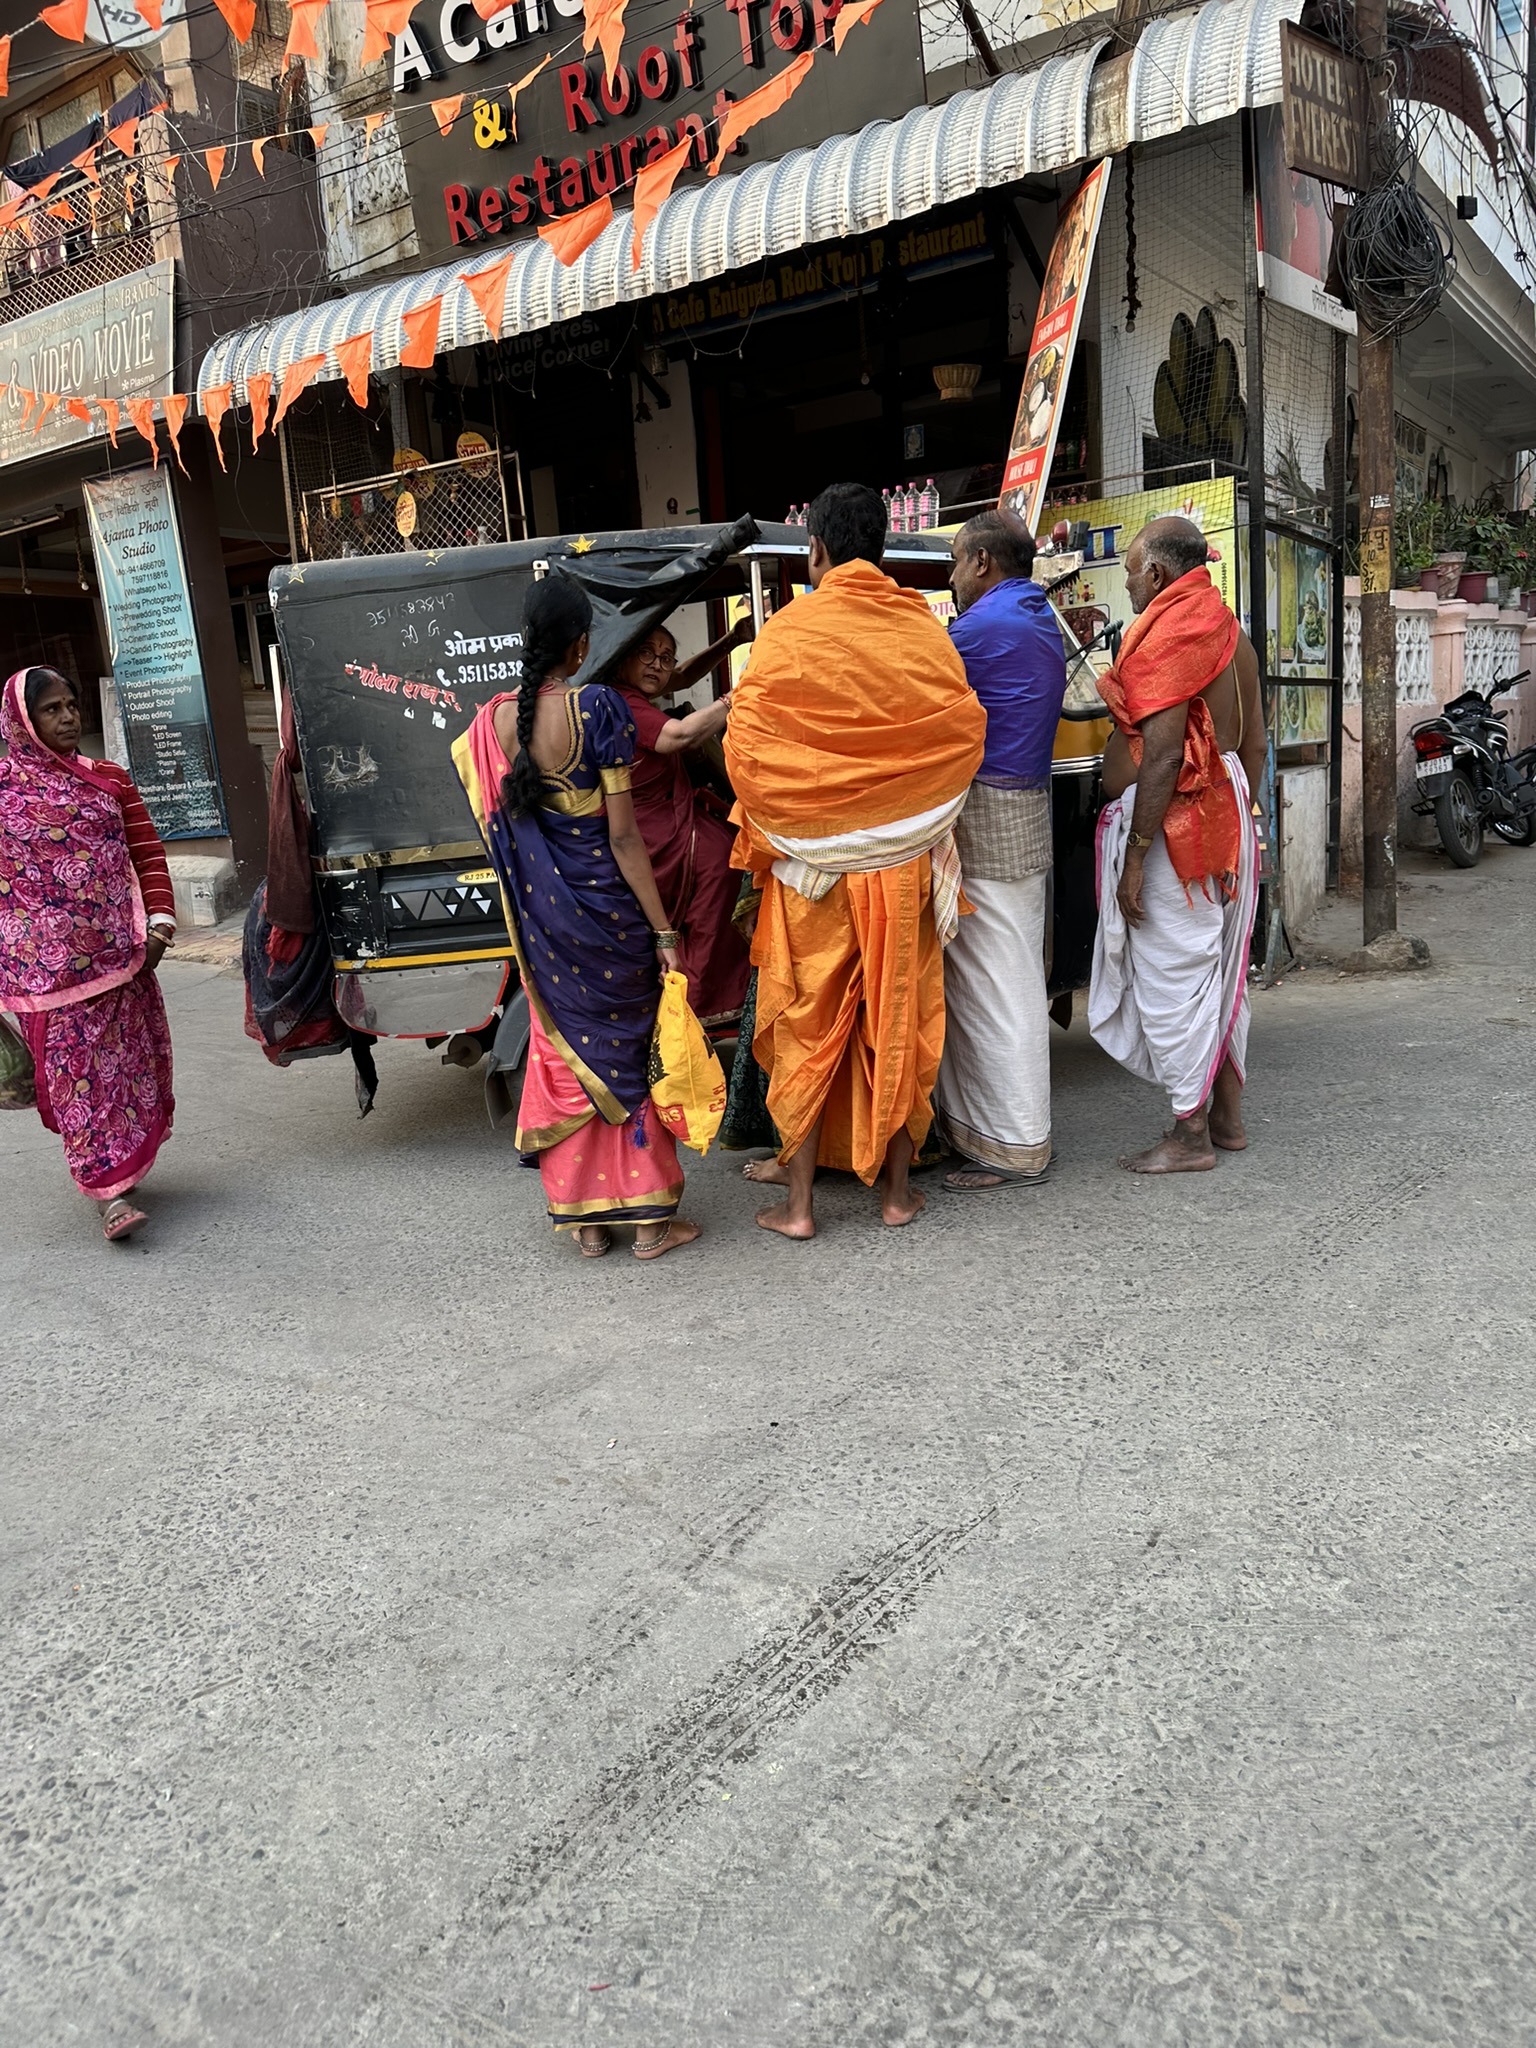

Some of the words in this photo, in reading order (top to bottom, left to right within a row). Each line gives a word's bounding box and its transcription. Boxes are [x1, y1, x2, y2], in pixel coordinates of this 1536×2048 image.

[393, 20, 432, 92] A
[472, 98, 508, 149] &
[559, 9, 694, 133] Roof
[1289, 40, 1346, 106] HOTEL
[1290, 95, 1361, 177] EVEREST
[443, 88, 738, 246] Restaurant
[668, 297, 707, 329] Cafe
[708, 275, 778, 321] Enigma
[779, 261, 824, 298] Roof
[827, 249, 867, 287] Top
[868, 210, 987, 274] Rstaurant
[30, 338, 85, 405] VIDEO
[93, 306, 155, 384] MOVIE
[129, 373, 155, 388] Plasma
[100, 526, 136, 547] Ajanta
[138, 519, 170, 537] Photo
[122, 541, 156, 560] Studio
[124, 586, 157, 599] (Whatsapp
[113, 600, 141, 612] Wedding
[142, 593, 184, 606] Photography
[162, 604, 183, 615] Shoot
[157, 617, 176, 628] Shoot
[161, 628, 179, 638] shoot
[153, 638, 194, 651] Photography
[444, 630, 487, 657] ओम
[164, 649, 193, 662] Highlight
[124, 669, 143, 679] Event
[143, 663, 184, 676] Photography
[126, 680, 152, 690] Product
[128, 690, 152, 700] Portrait
[152, 685, 192, 697] Photography
[130, 701, 155, 711] Outdoor
[156, 698, 175, 708] Shoot
[132, 712, 151, 722] Photo
[151, 710, 173, 720] editing
